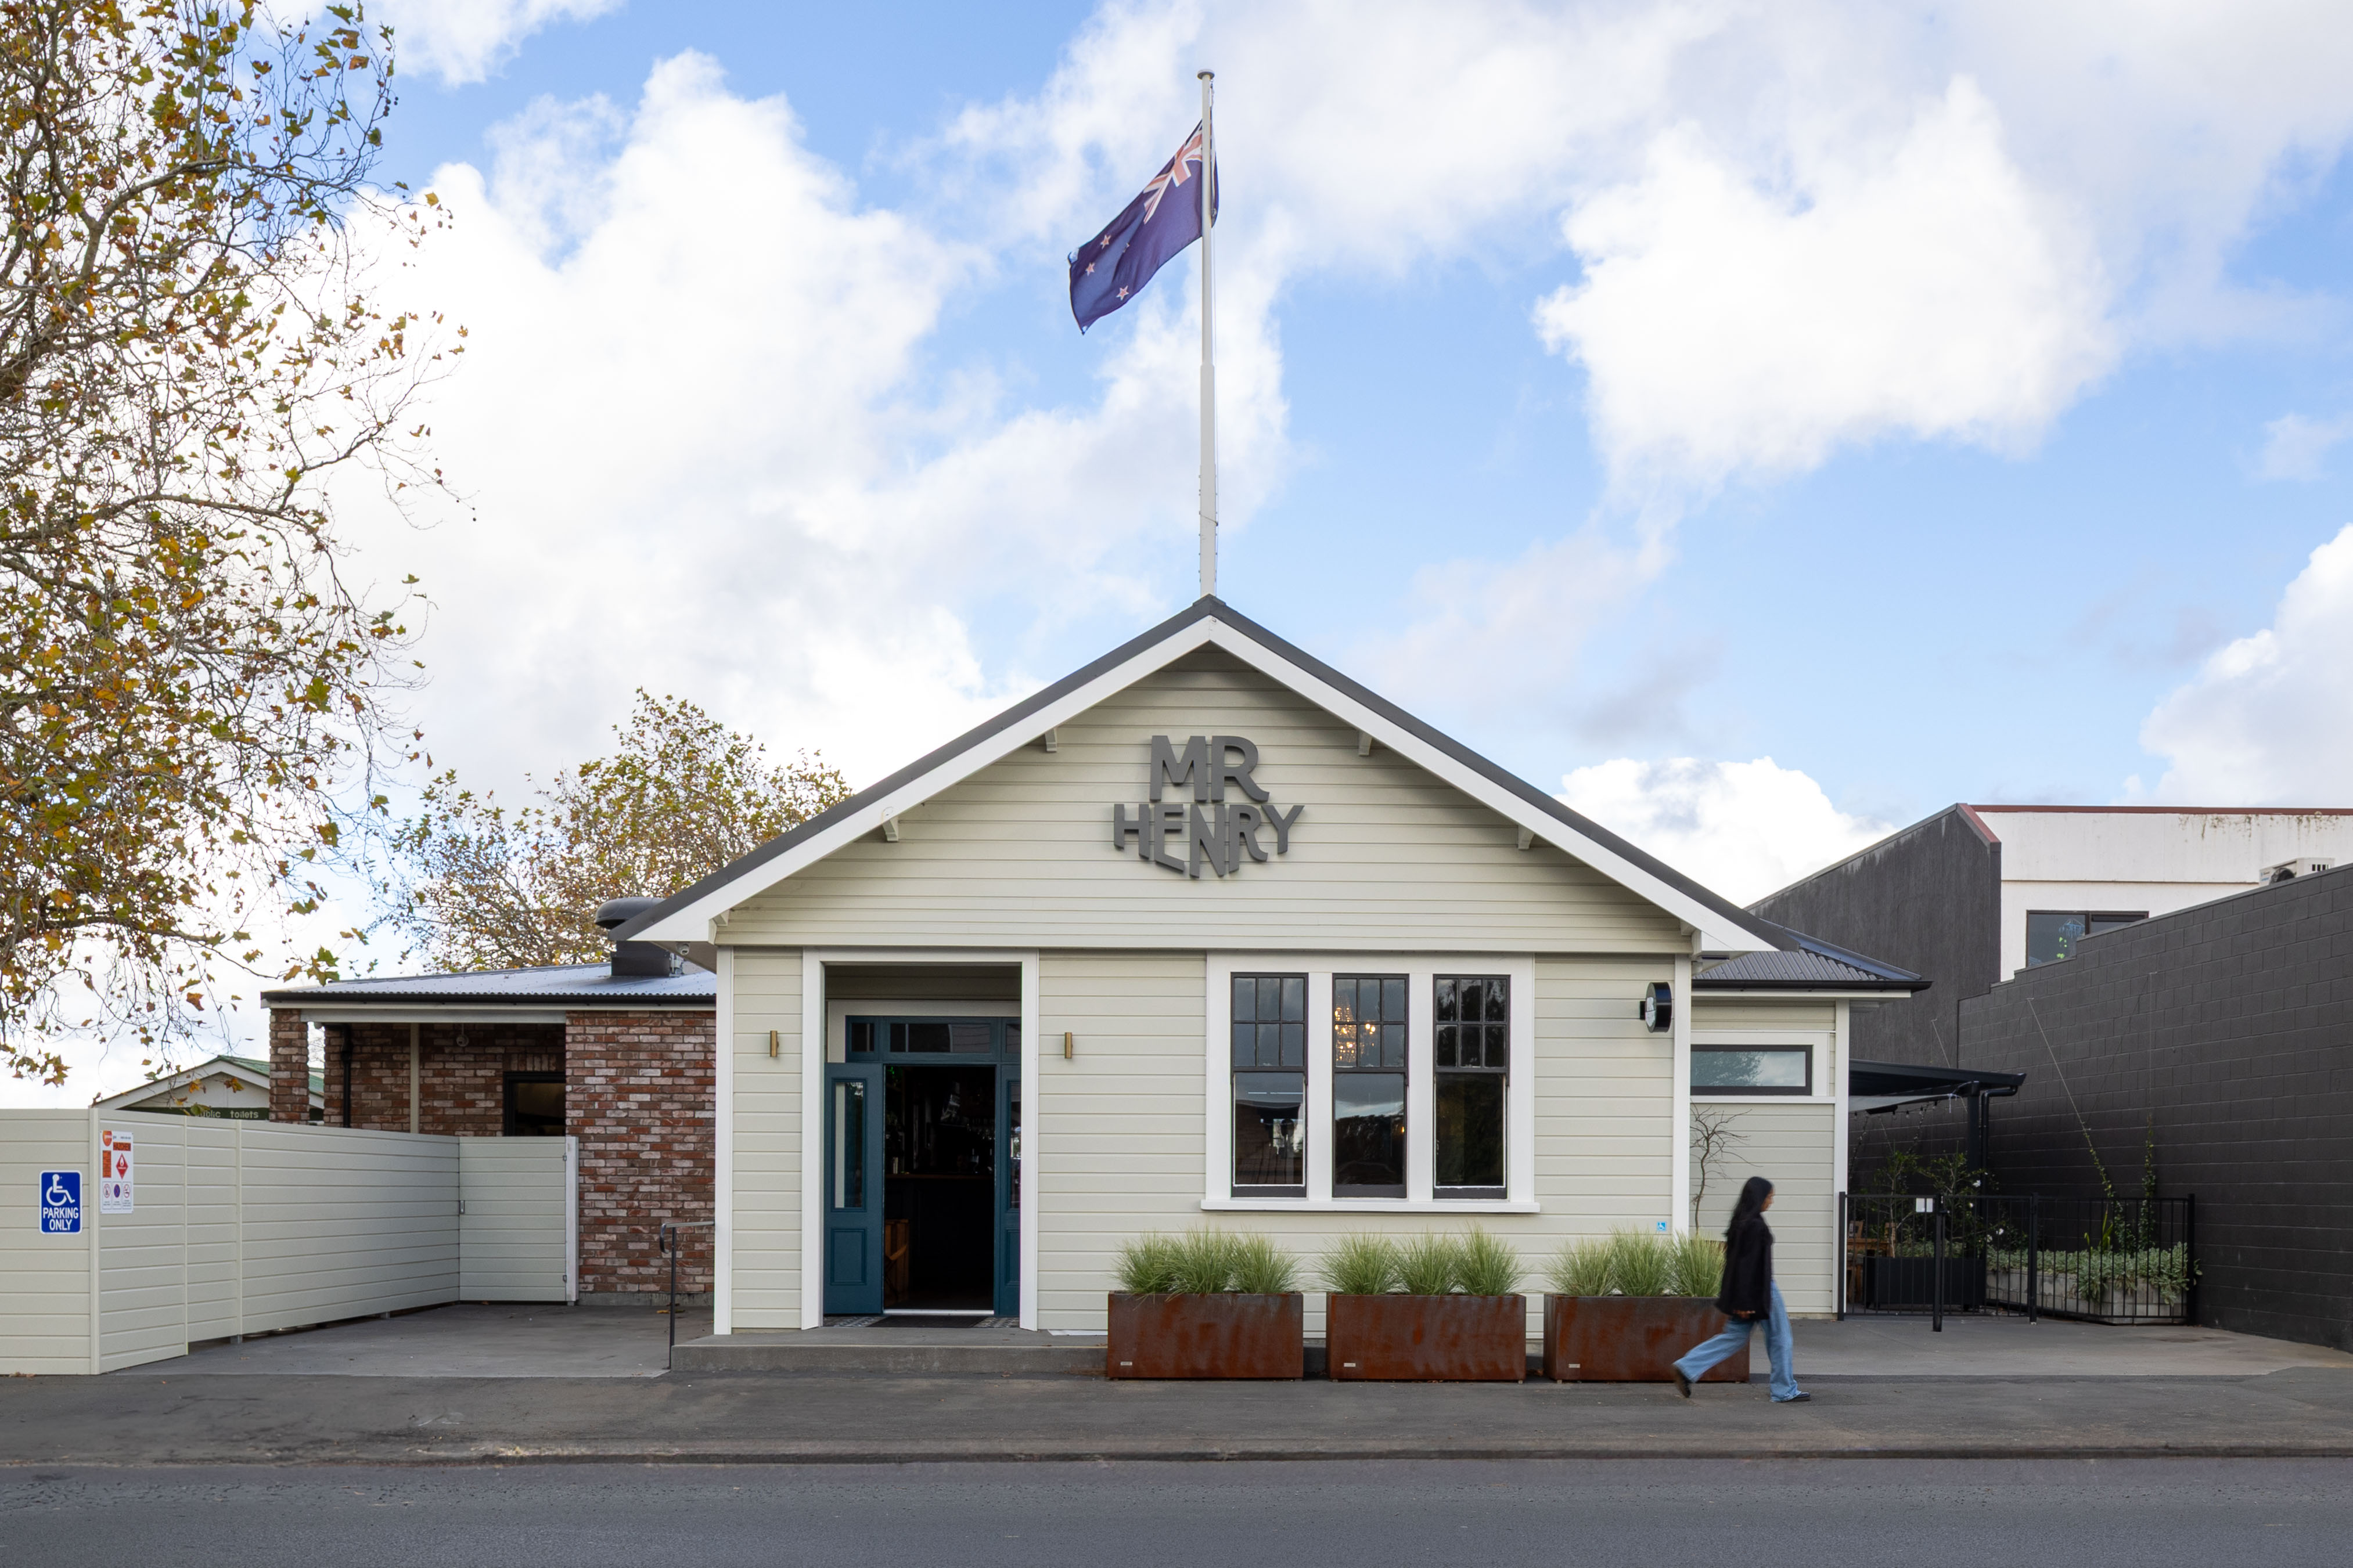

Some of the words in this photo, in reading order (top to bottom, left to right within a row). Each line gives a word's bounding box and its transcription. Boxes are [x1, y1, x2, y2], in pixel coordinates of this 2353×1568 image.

[1150, 735, 1270, 802] MR
[1114, 803, 1305, 878] HENRY
[197, 1109, 221, 1118] ublic
[230, 1110, 259, 1119] toilets
[43, 1207, 79, 1219] PARKING
[49, 1219, 73, 1231] ONLY
